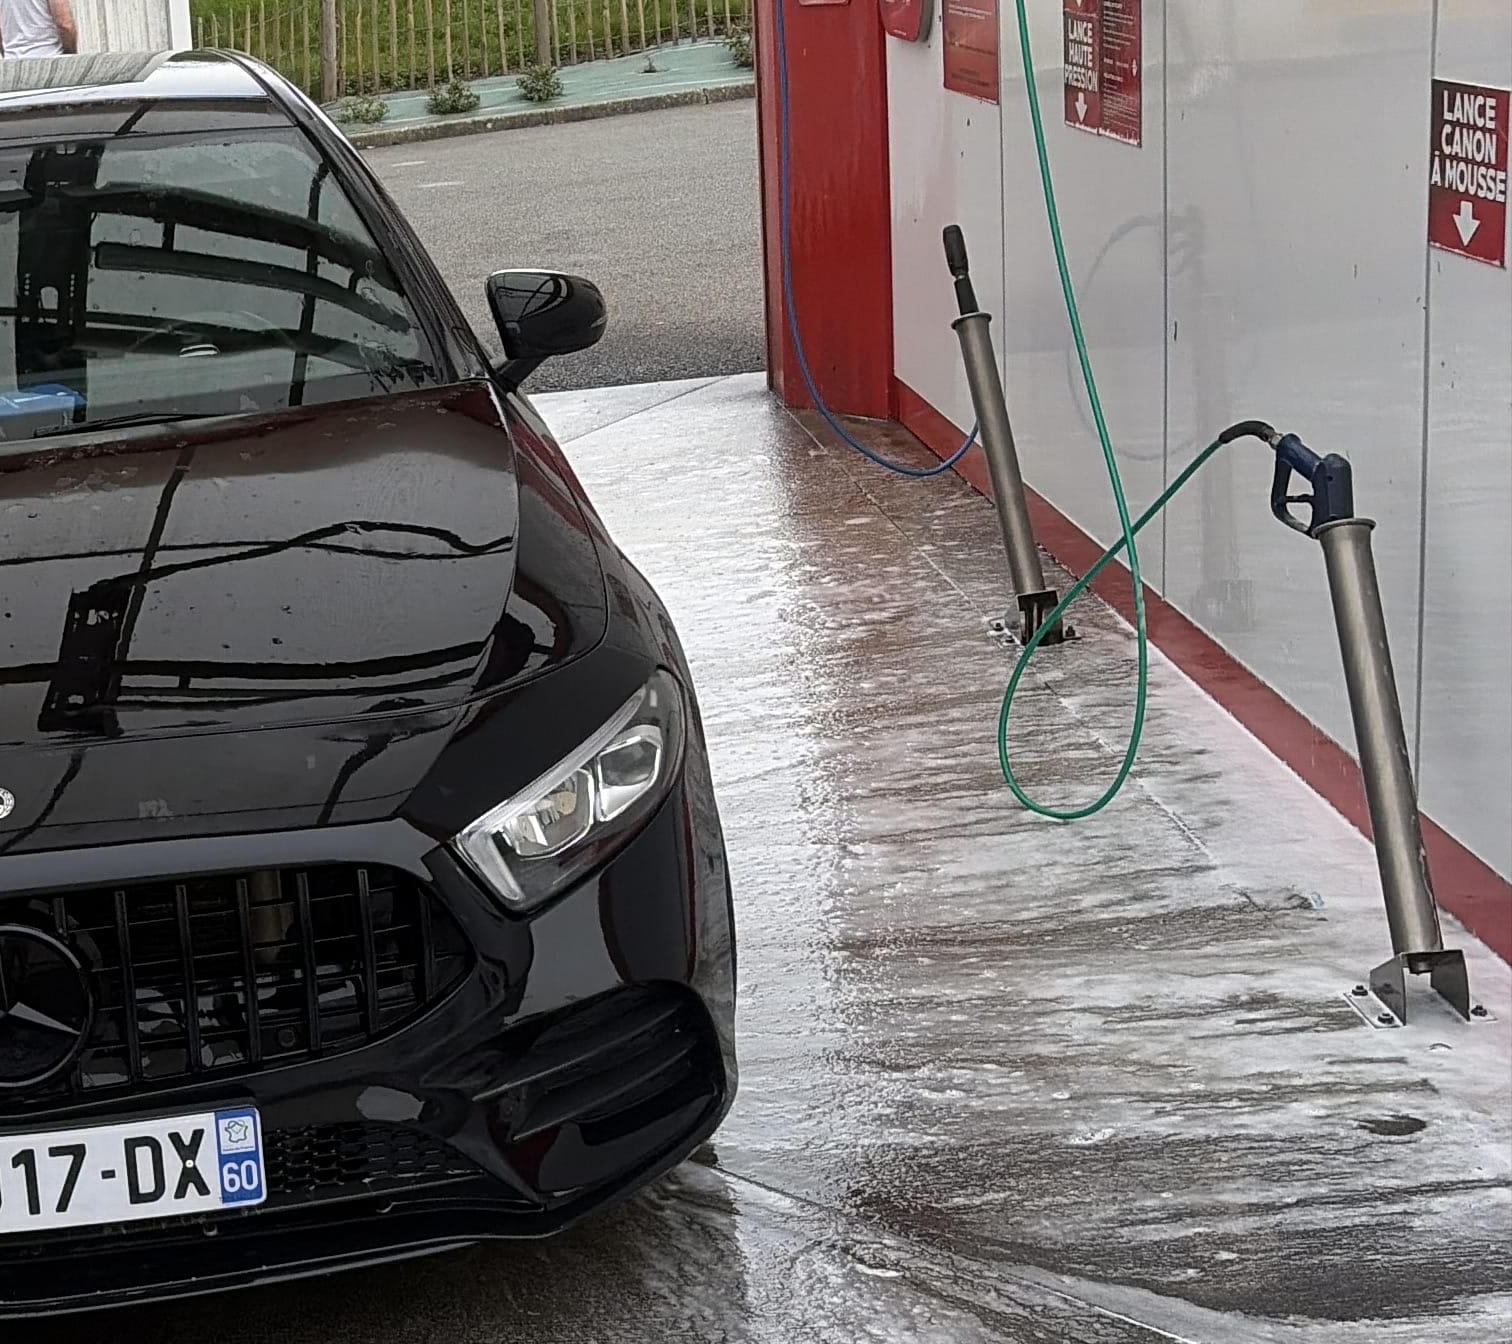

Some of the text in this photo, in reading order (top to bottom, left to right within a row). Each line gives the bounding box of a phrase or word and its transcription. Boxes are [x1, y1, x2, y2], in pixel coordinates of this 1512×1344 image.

[1068, 18, 1093, 44] LANCE
[1068, 41, 1093, 68] HAUTE
[1064, 63, 1098, 93] PRESSION
[1442, 89, 1497, 129] LANCE
[1441, 123, 1497, 165] CANON
[1444, 158, 1507, 203] MOUSSE
[222, 1159, 259, 1193] 60
